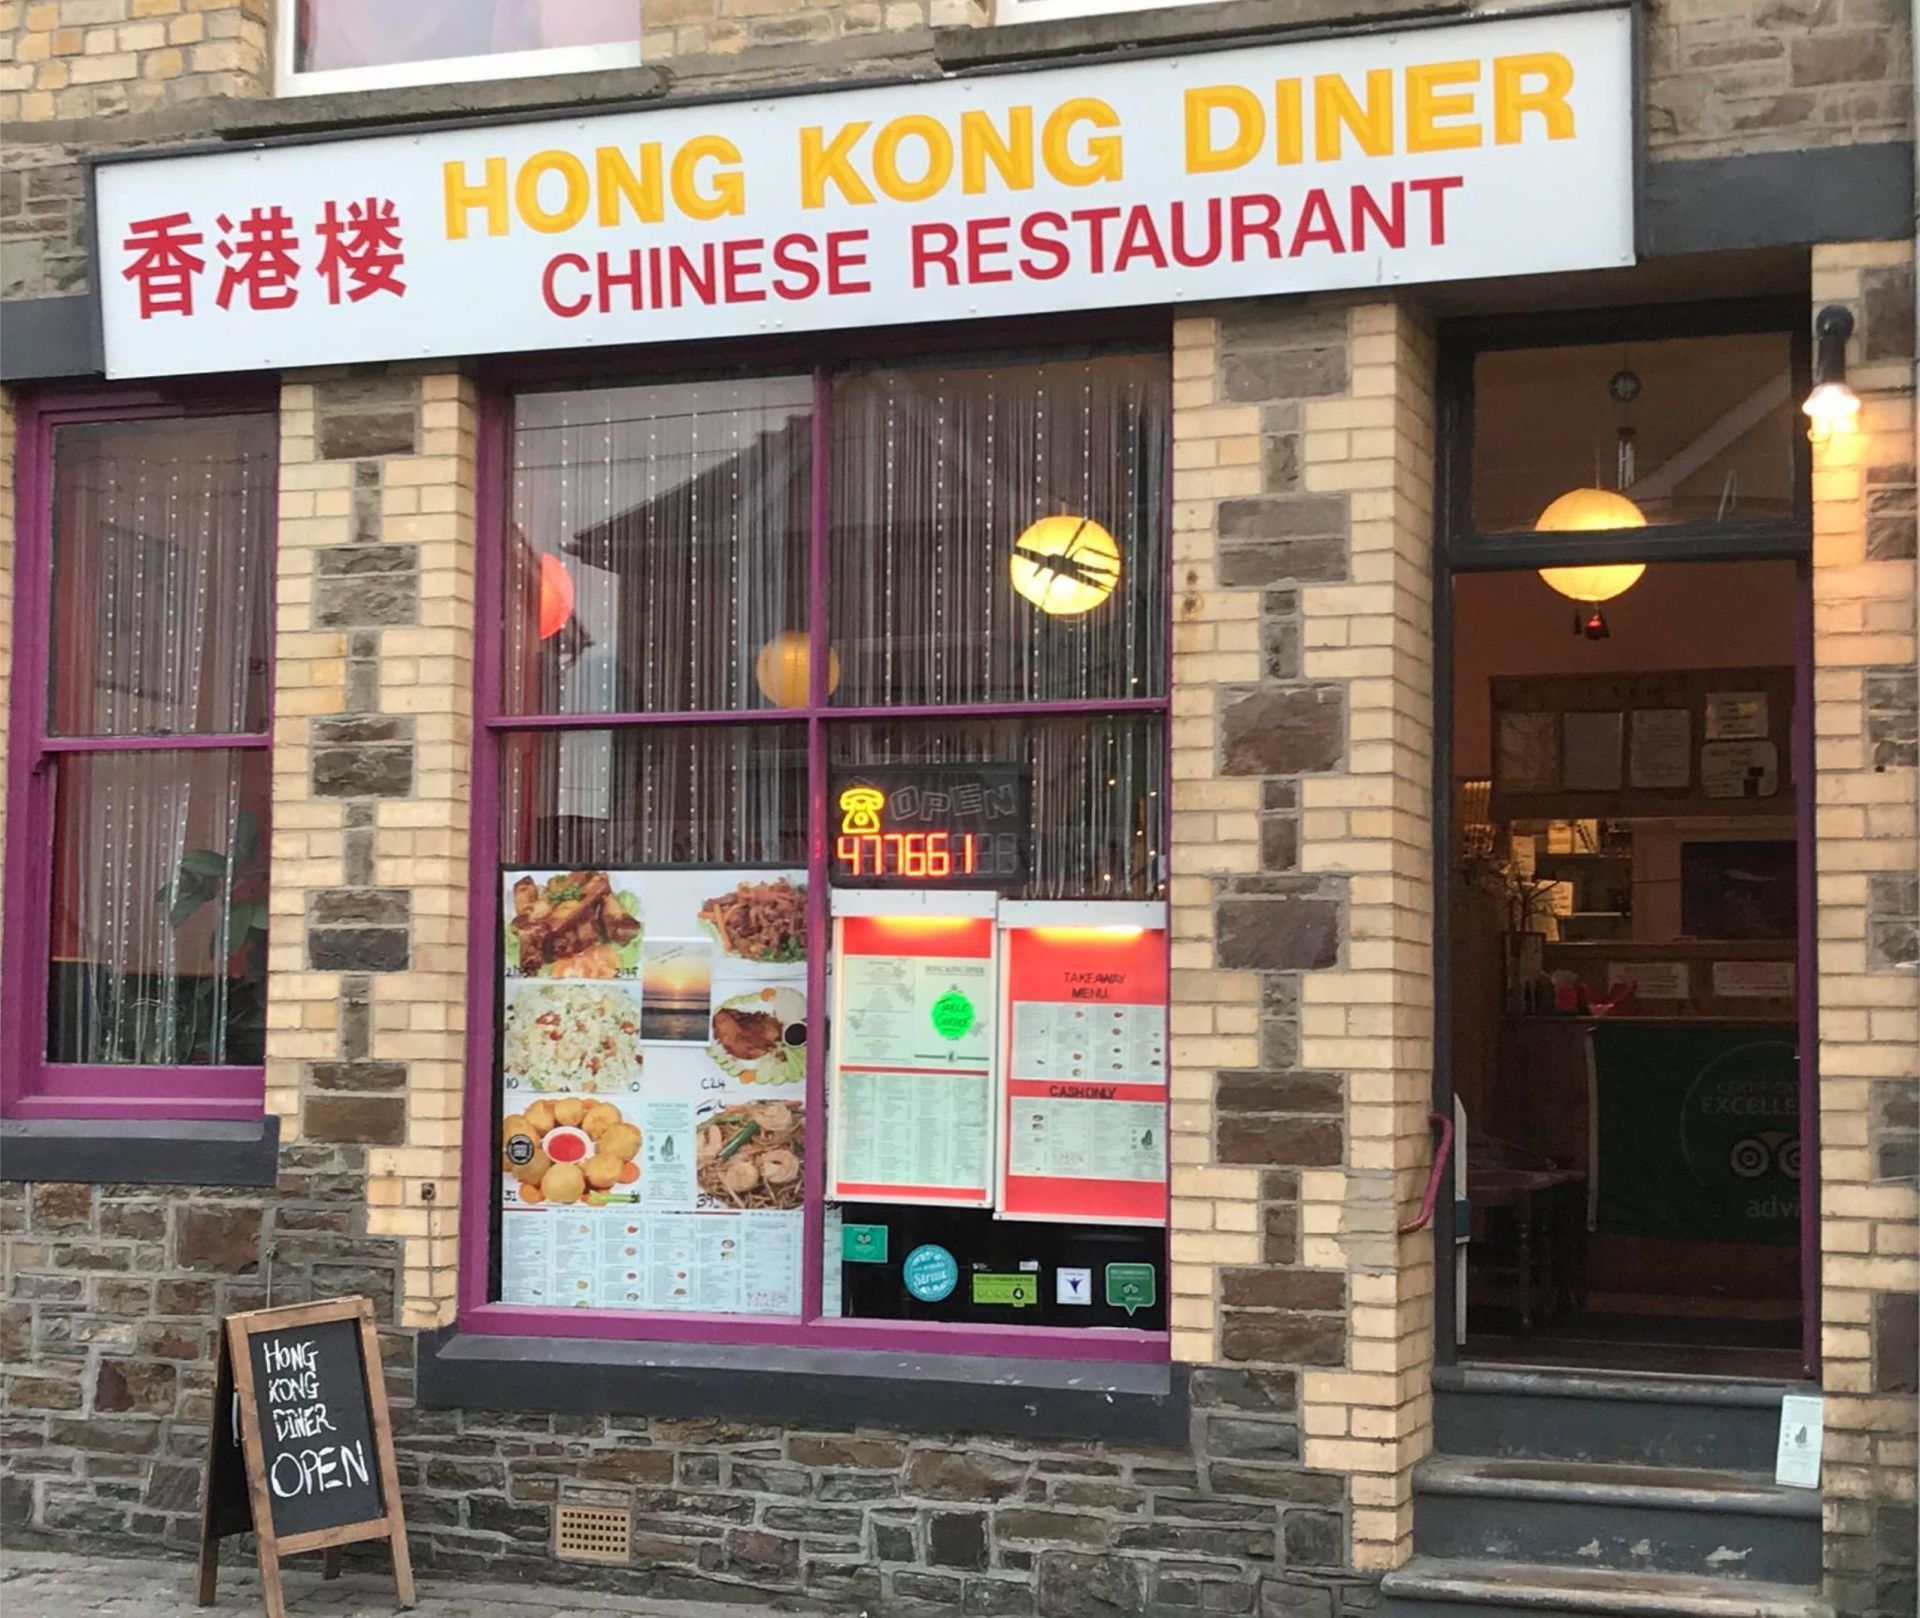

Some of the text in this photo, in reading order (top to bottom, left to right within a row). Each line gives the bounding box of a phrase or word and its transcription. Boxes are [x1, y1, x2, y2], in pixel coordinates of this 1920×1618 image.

[445, 52, 1574, 239] HONG KONG DINER
[124, 199, 405, 319] 香港楼
[543, 177, 1463, 318] CHINESE RESTAURANT
[889, 783, 1017, 821] OPEN
[836, 833, 976, 876] 477661
[1063, 972, 1126, 984] TAKEAWAY
[263, 1338, 319, 1374] HONG
[269, 1371, 321, 1403] KONG
[273, 1404, 337, 1442] DINER
[271, 1440, 370, 1499] OPEN
